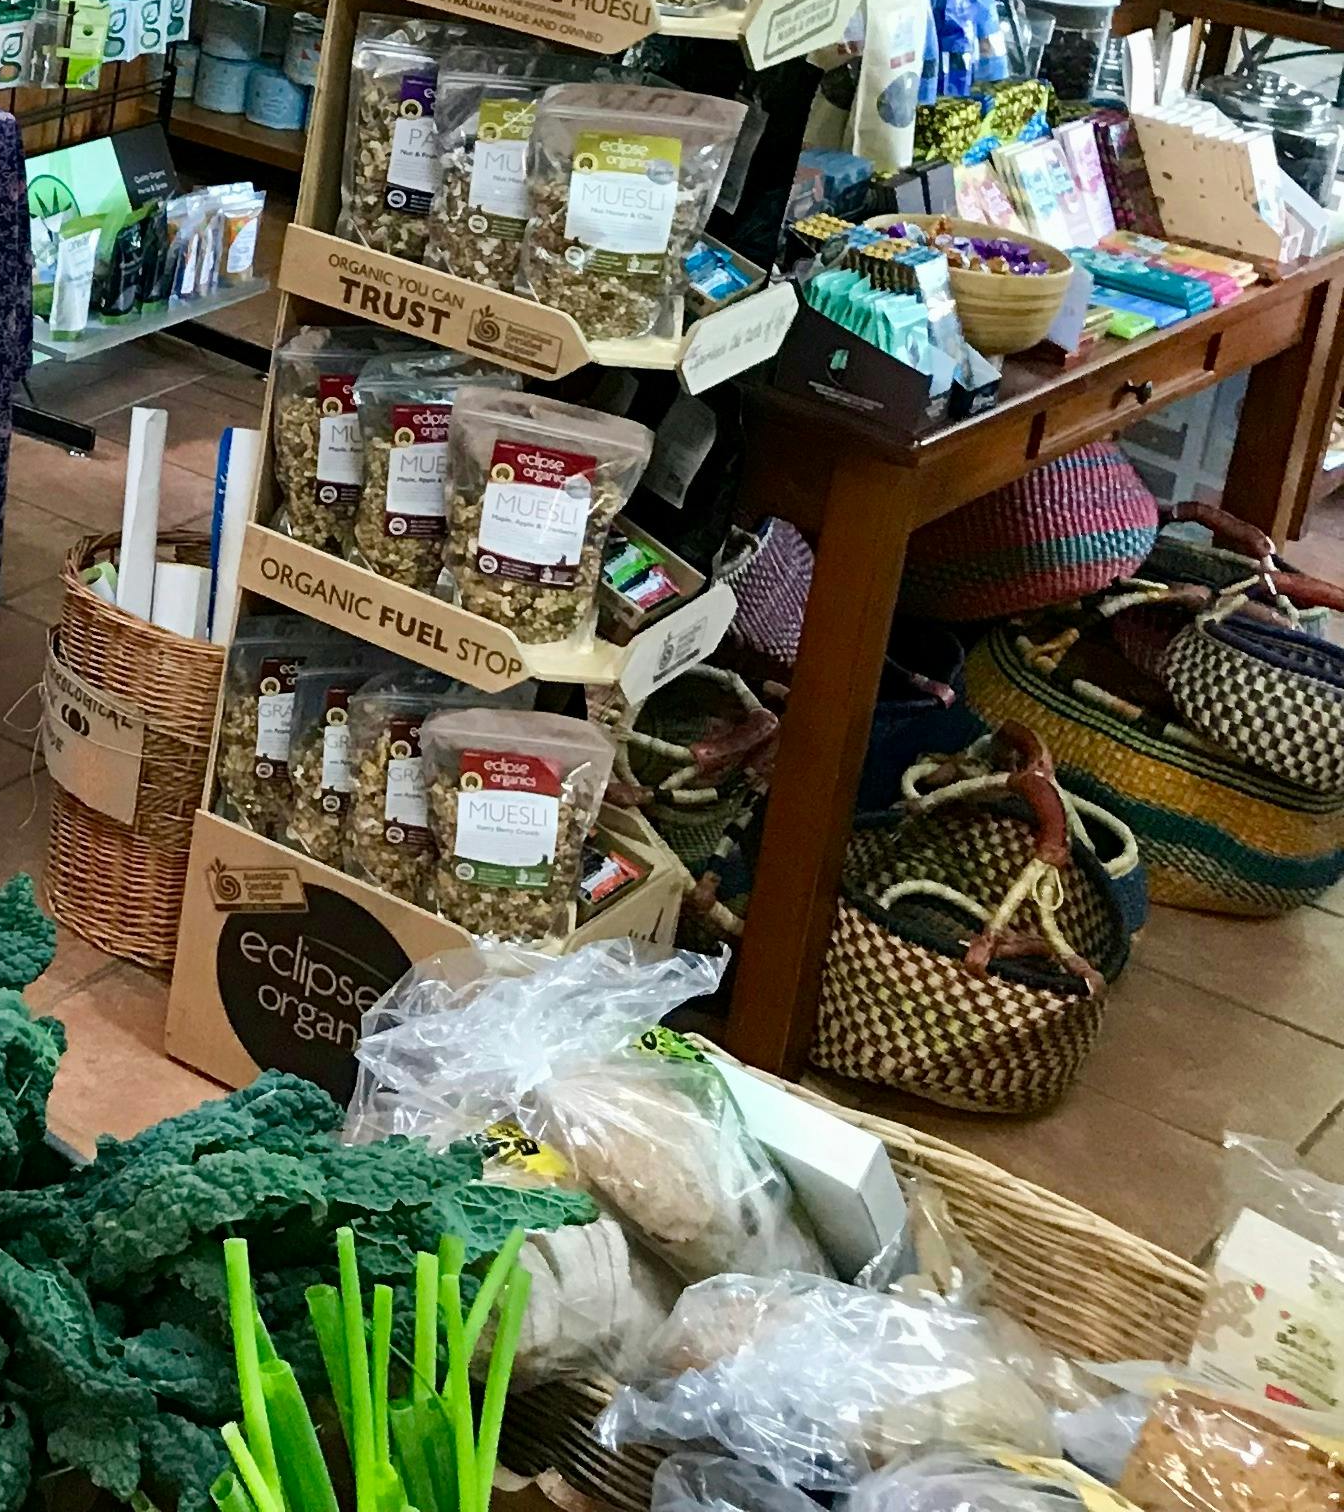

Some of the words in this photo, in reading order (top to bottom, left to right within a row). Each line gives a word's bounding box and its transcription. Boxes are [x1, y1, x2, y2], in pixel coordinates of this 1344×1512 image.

[599, 138, 649, 158] eclipse
[581, 182, 665, 211] MUESLI
[328, 253, 394, 287] ORGANIC
[397, 275, 429, 296] YOU
[431, 287, 465, 309] CAN
[338, 275, 451, 335] TRUST
[517, 452, 565, 470] eclipse
[523, 467, 569, 483] organic
[495, 492, 578, 525] MUESLI
[260, 557, 372, 622] ORGANIC
[378, 605, 449, 654] FUEL
[456, 638, 524, 680] STOP
[483, 757, 530, 775] eclipse
[490, 774, 537, 787] organics
[468, 800, 548, 827] MUESLI
[239, 931, 381, 1014] eclipse
